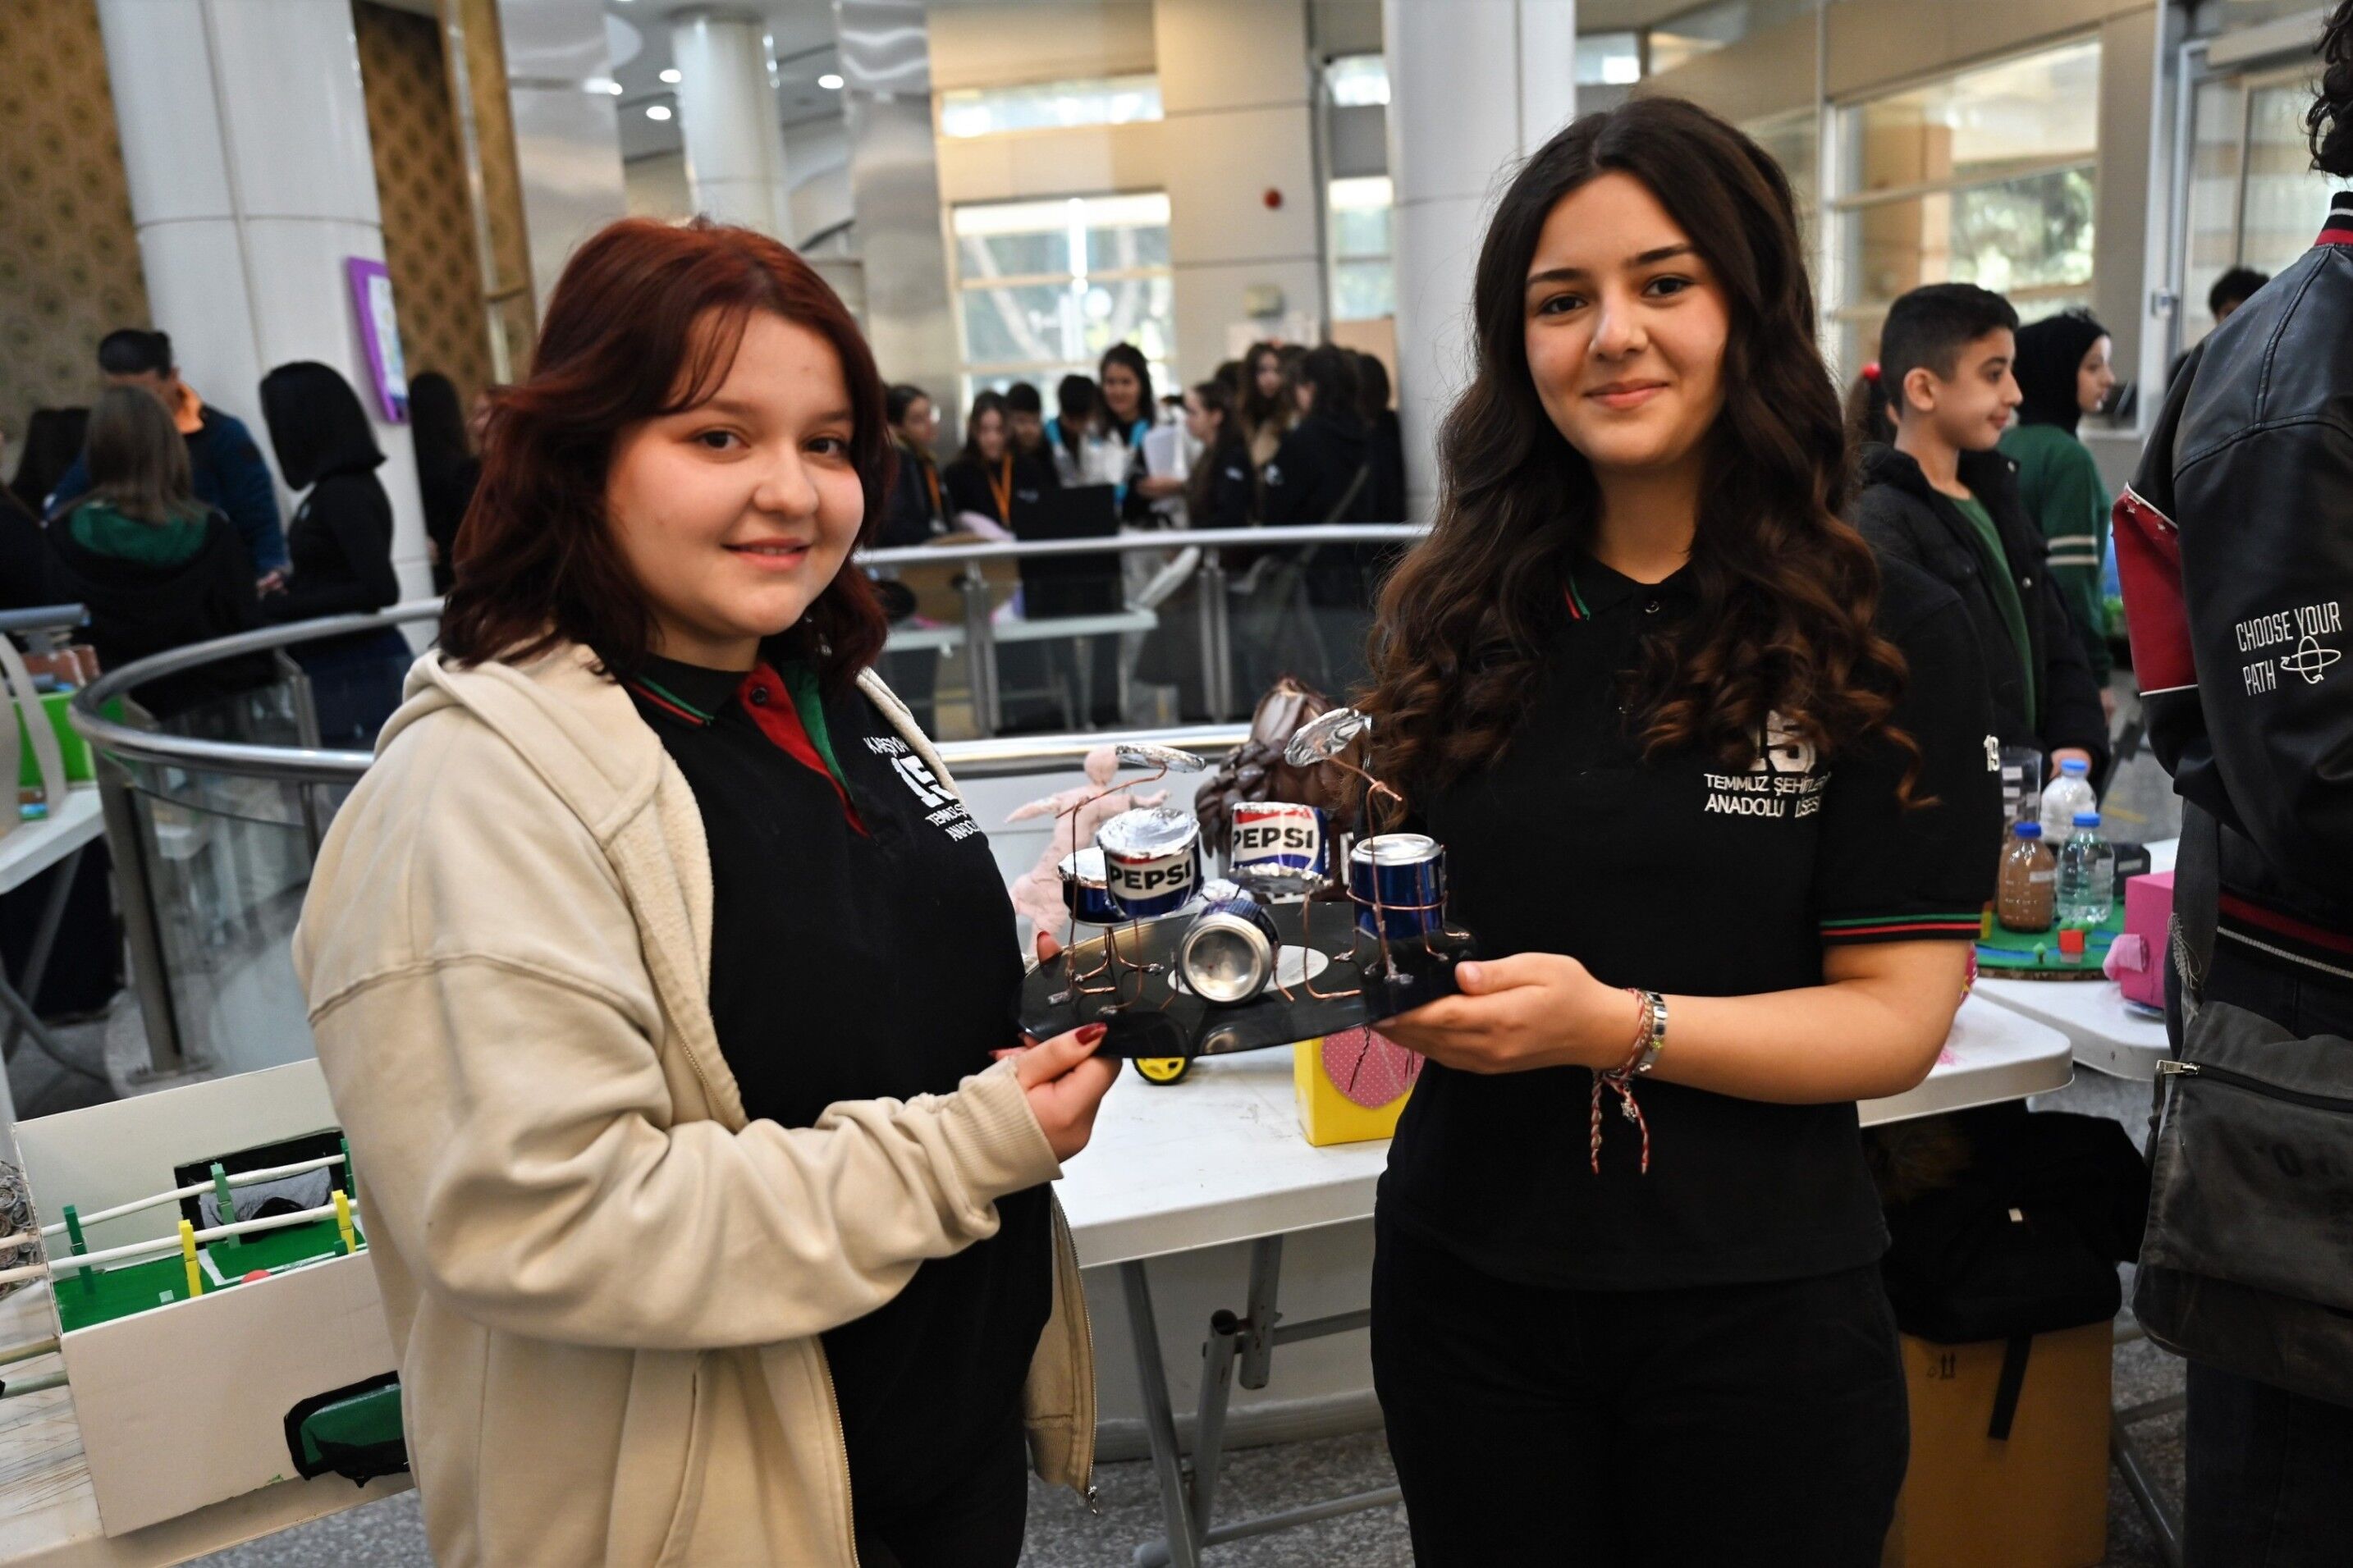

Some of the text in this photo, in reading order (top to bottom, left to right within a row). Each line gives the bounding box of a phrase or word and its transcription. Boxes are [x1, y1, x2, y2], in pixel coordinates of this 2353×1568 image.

[2236, 601, 2342, 652] CHOOSE YOUR
[2242, 659, 2277, 697] PATH
[890, 755, 960, 808] 15
[1704, 773, 1770, 792] TEMMUZ
[1704, 793, 1786, 817] ANADOLU
[1110, 858, 1190, 890] PEPSI
